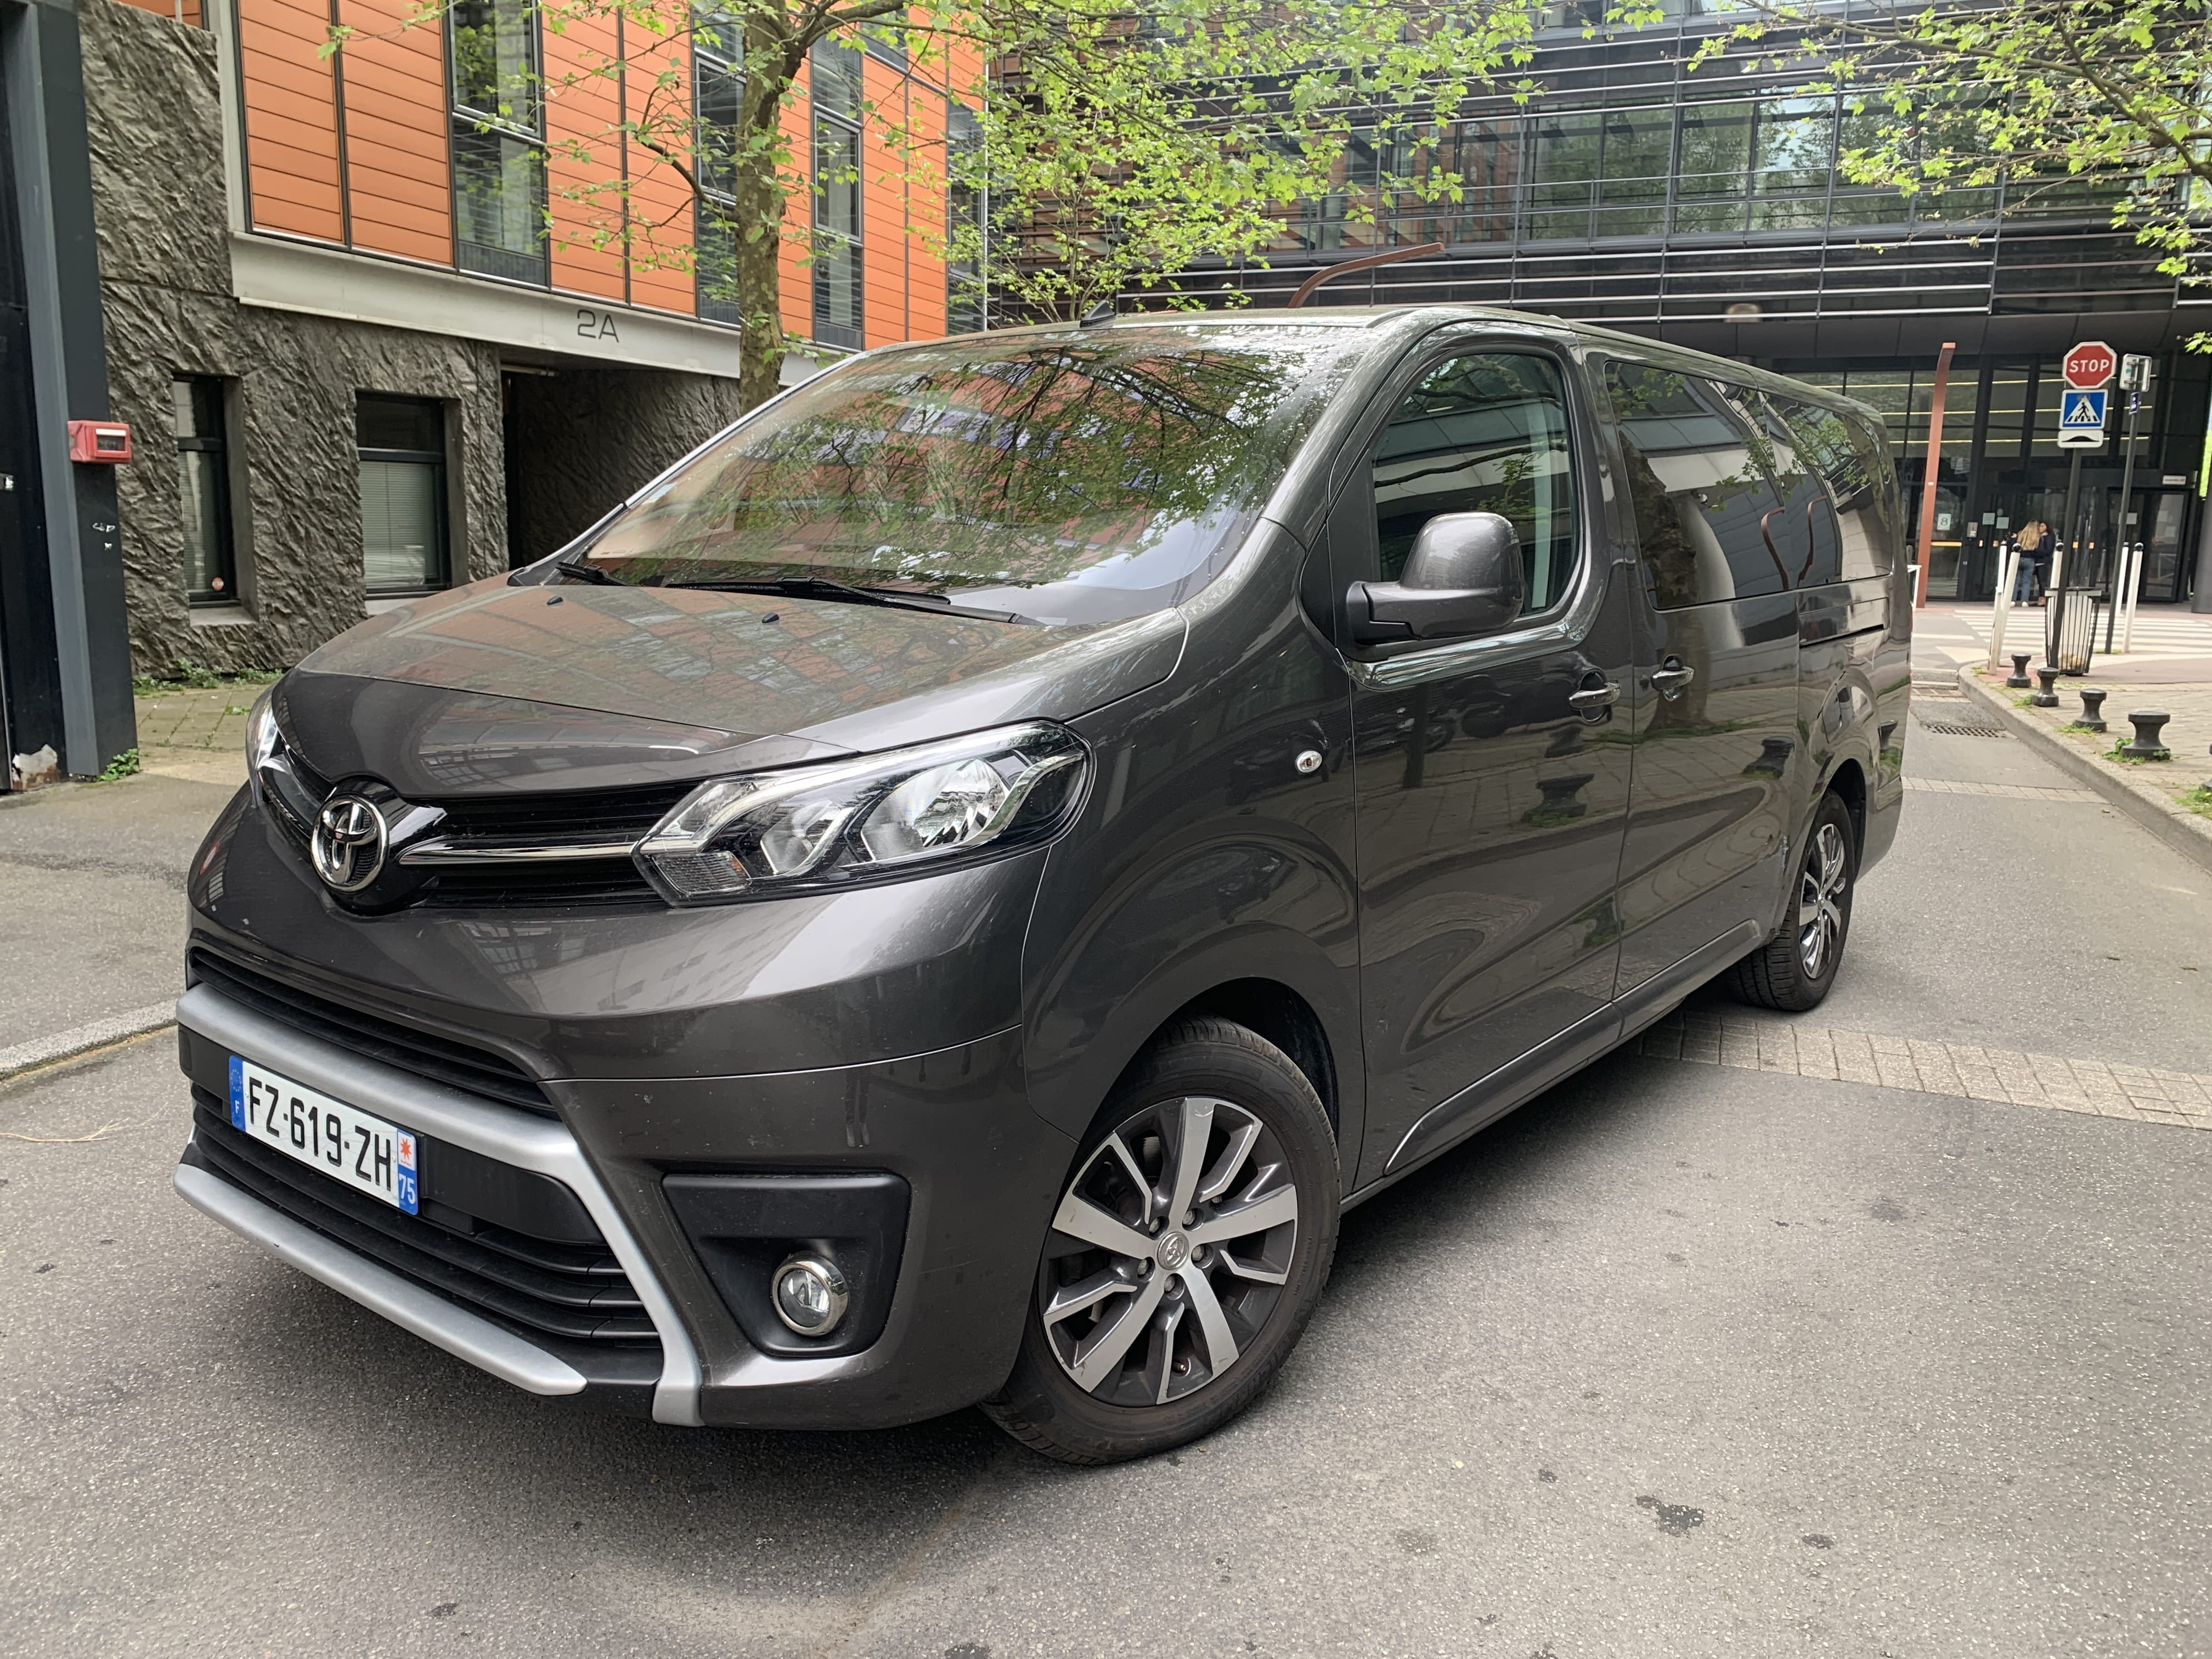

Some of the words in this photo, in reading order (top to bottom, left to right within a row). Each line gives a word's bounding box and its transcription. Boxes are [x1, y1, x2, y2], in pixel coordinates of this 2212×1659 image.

[577, 309, 619, 343] 2A
[2069, 359, 2110, 373] STOP
[1941, 517, 1948, 526] 8
[235, 1099, 240, 1114] F
[249, 1076, 392, 1192] FZ-619-ZH
[399, 1173, 415, 1205] 75
